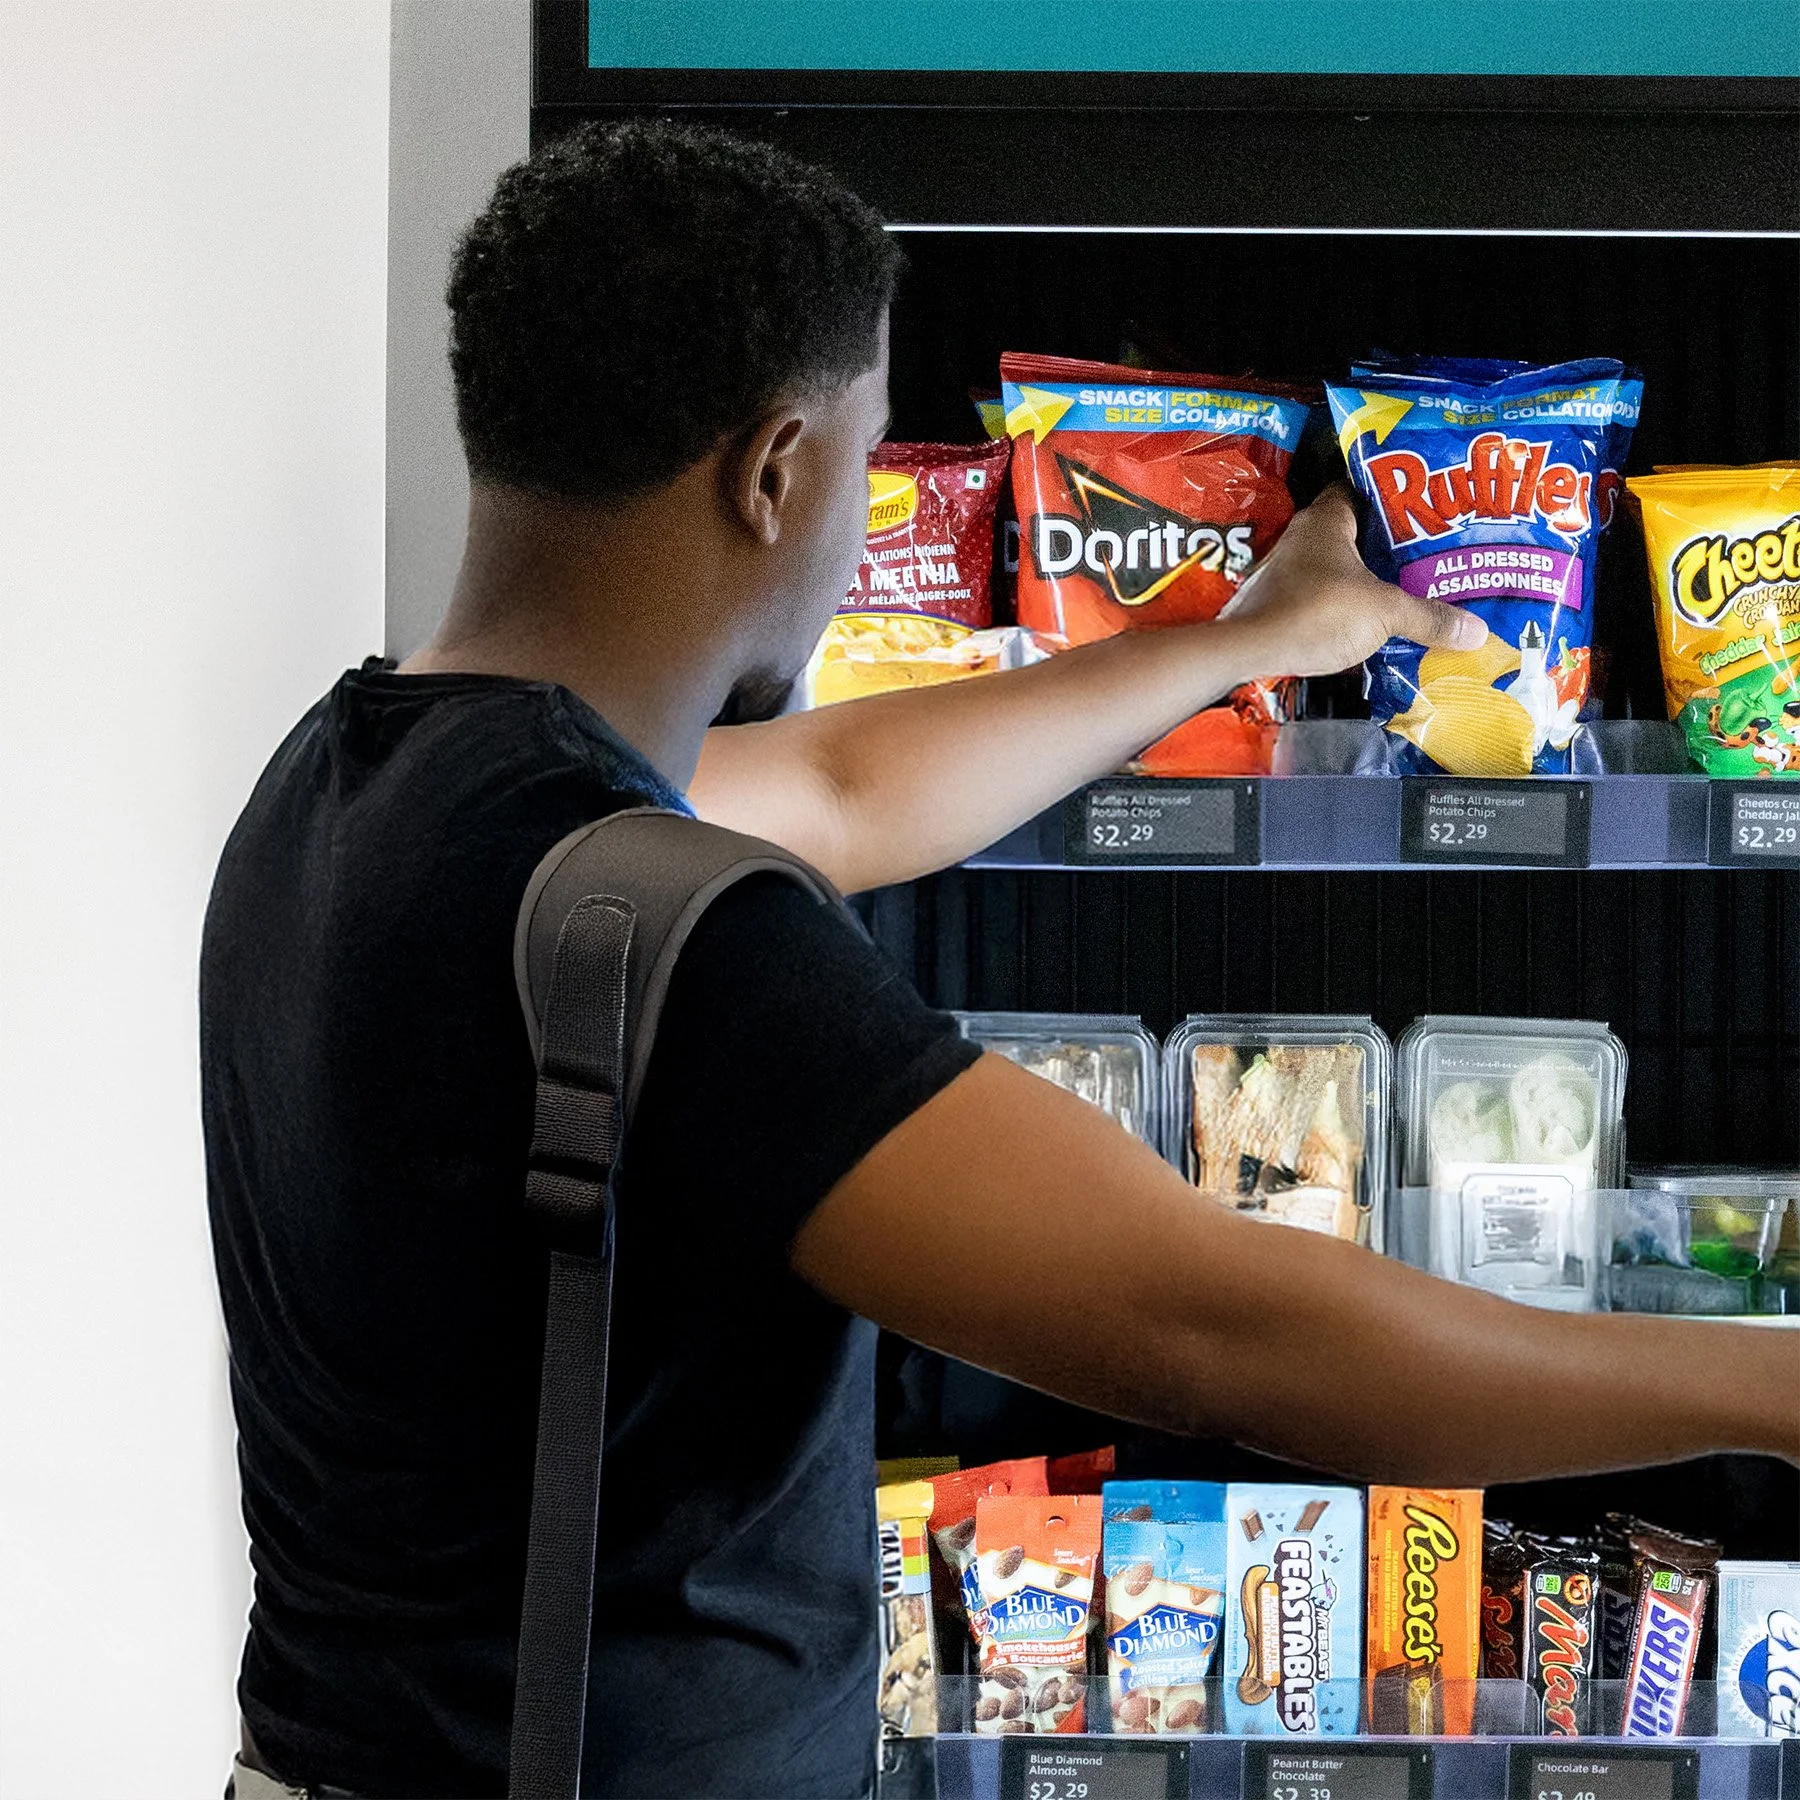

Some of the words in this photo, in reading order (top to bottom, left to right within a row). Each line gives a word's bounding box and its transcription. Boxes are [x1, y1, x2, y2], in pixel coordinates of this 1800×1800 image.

[1079, 390, 1163, 407] SNACK
[1171, 392, 1274, 413] FORMAT
[1418, 396, 1495, 413] SNACK
[1502, 387, 1600, 410] FORMAT
[1105, 408, 1162, 424] SIZE
[1443, 411, 1496, 426] SIZE
[1502, 402, 1613, 420] COLLATION
[1169, 409, 1289, 440] COLLATION
[1364, 432, 1592, 549] Ruffles
[868, 498, 909, 520] ram's
[860, 547, 911, 564] OLLATIONS
[1037, 520, 1253, 581] Doritos
[1434, 559, 1469, 577] ALL
[1471, 551, 1554, 574] DRESSED
[1674, 515, 1800, 624] Cheet
[870, 562, 961, 591] MEETHA
[1426, 570, 1564, 599] ASSAISONNÉES
[1733, 583, 1800, 618] CRUNCHY
[1742, 599, 1800, 631] CROUAN
[1699, 633, 1767, 676] Cheddar
[1428, 806, 1464, 817] Potato
[1467, 807, 1497, 818] Chips
[1429, 795, 1465, 806] Ruffles
[1467, 795, 1482, 806] All
[1484, 796, 1525, 808] Dressed
[1738, 798, 1780, 809] Cheetos
[1781, 799, 1800, 810] Cru
[1737, 809, 1782, 821] Cheddar
[1785, 810, 1800, 823] Jal
[1092, 824, 1154, 847] $2.29
[1429, 823, 1487, 845] $2.29
[1738, 826, 1797, 848] $2.29
[1402, 1506, 1460, 1665] Reese's
[1545, 1577, 1554, 1592] 240
[1659, 1572, 1671, 1590] 250
[1006, 1594, 1058, 1617] BLUE
[986, 1605, 1086, 1635] DIAMOND
[1138, 1613, 1192, 1638] BLUE
[1114, 1622, 1218, 1658] DIAMOND
[1279, 1540, 1316, 1732] FEASTABLES
[995, 1641, 1079, 1654] Smokehouse
[1535, 1596, 1590, 1736] Mar
[1628, 1604, 1691, 1736] ICKERS
[1029, 1766, 1077, 1776] Almonds
[1030, 1755, 1053, 1764] Blue
[1056, 1755, 1103, 1766] Diamond
[1273, 1759, 1309, 1769] Peanut
[1312, 1760, 1343, 1770] Butter
[1538, 1763, 1589, 1774] Chocolate
[1592, 1765, 1609, 1774] Bar
[1272, 1771, 1325, 1781] Chocolate
[1273, 1787, 1331, 1800] $239
